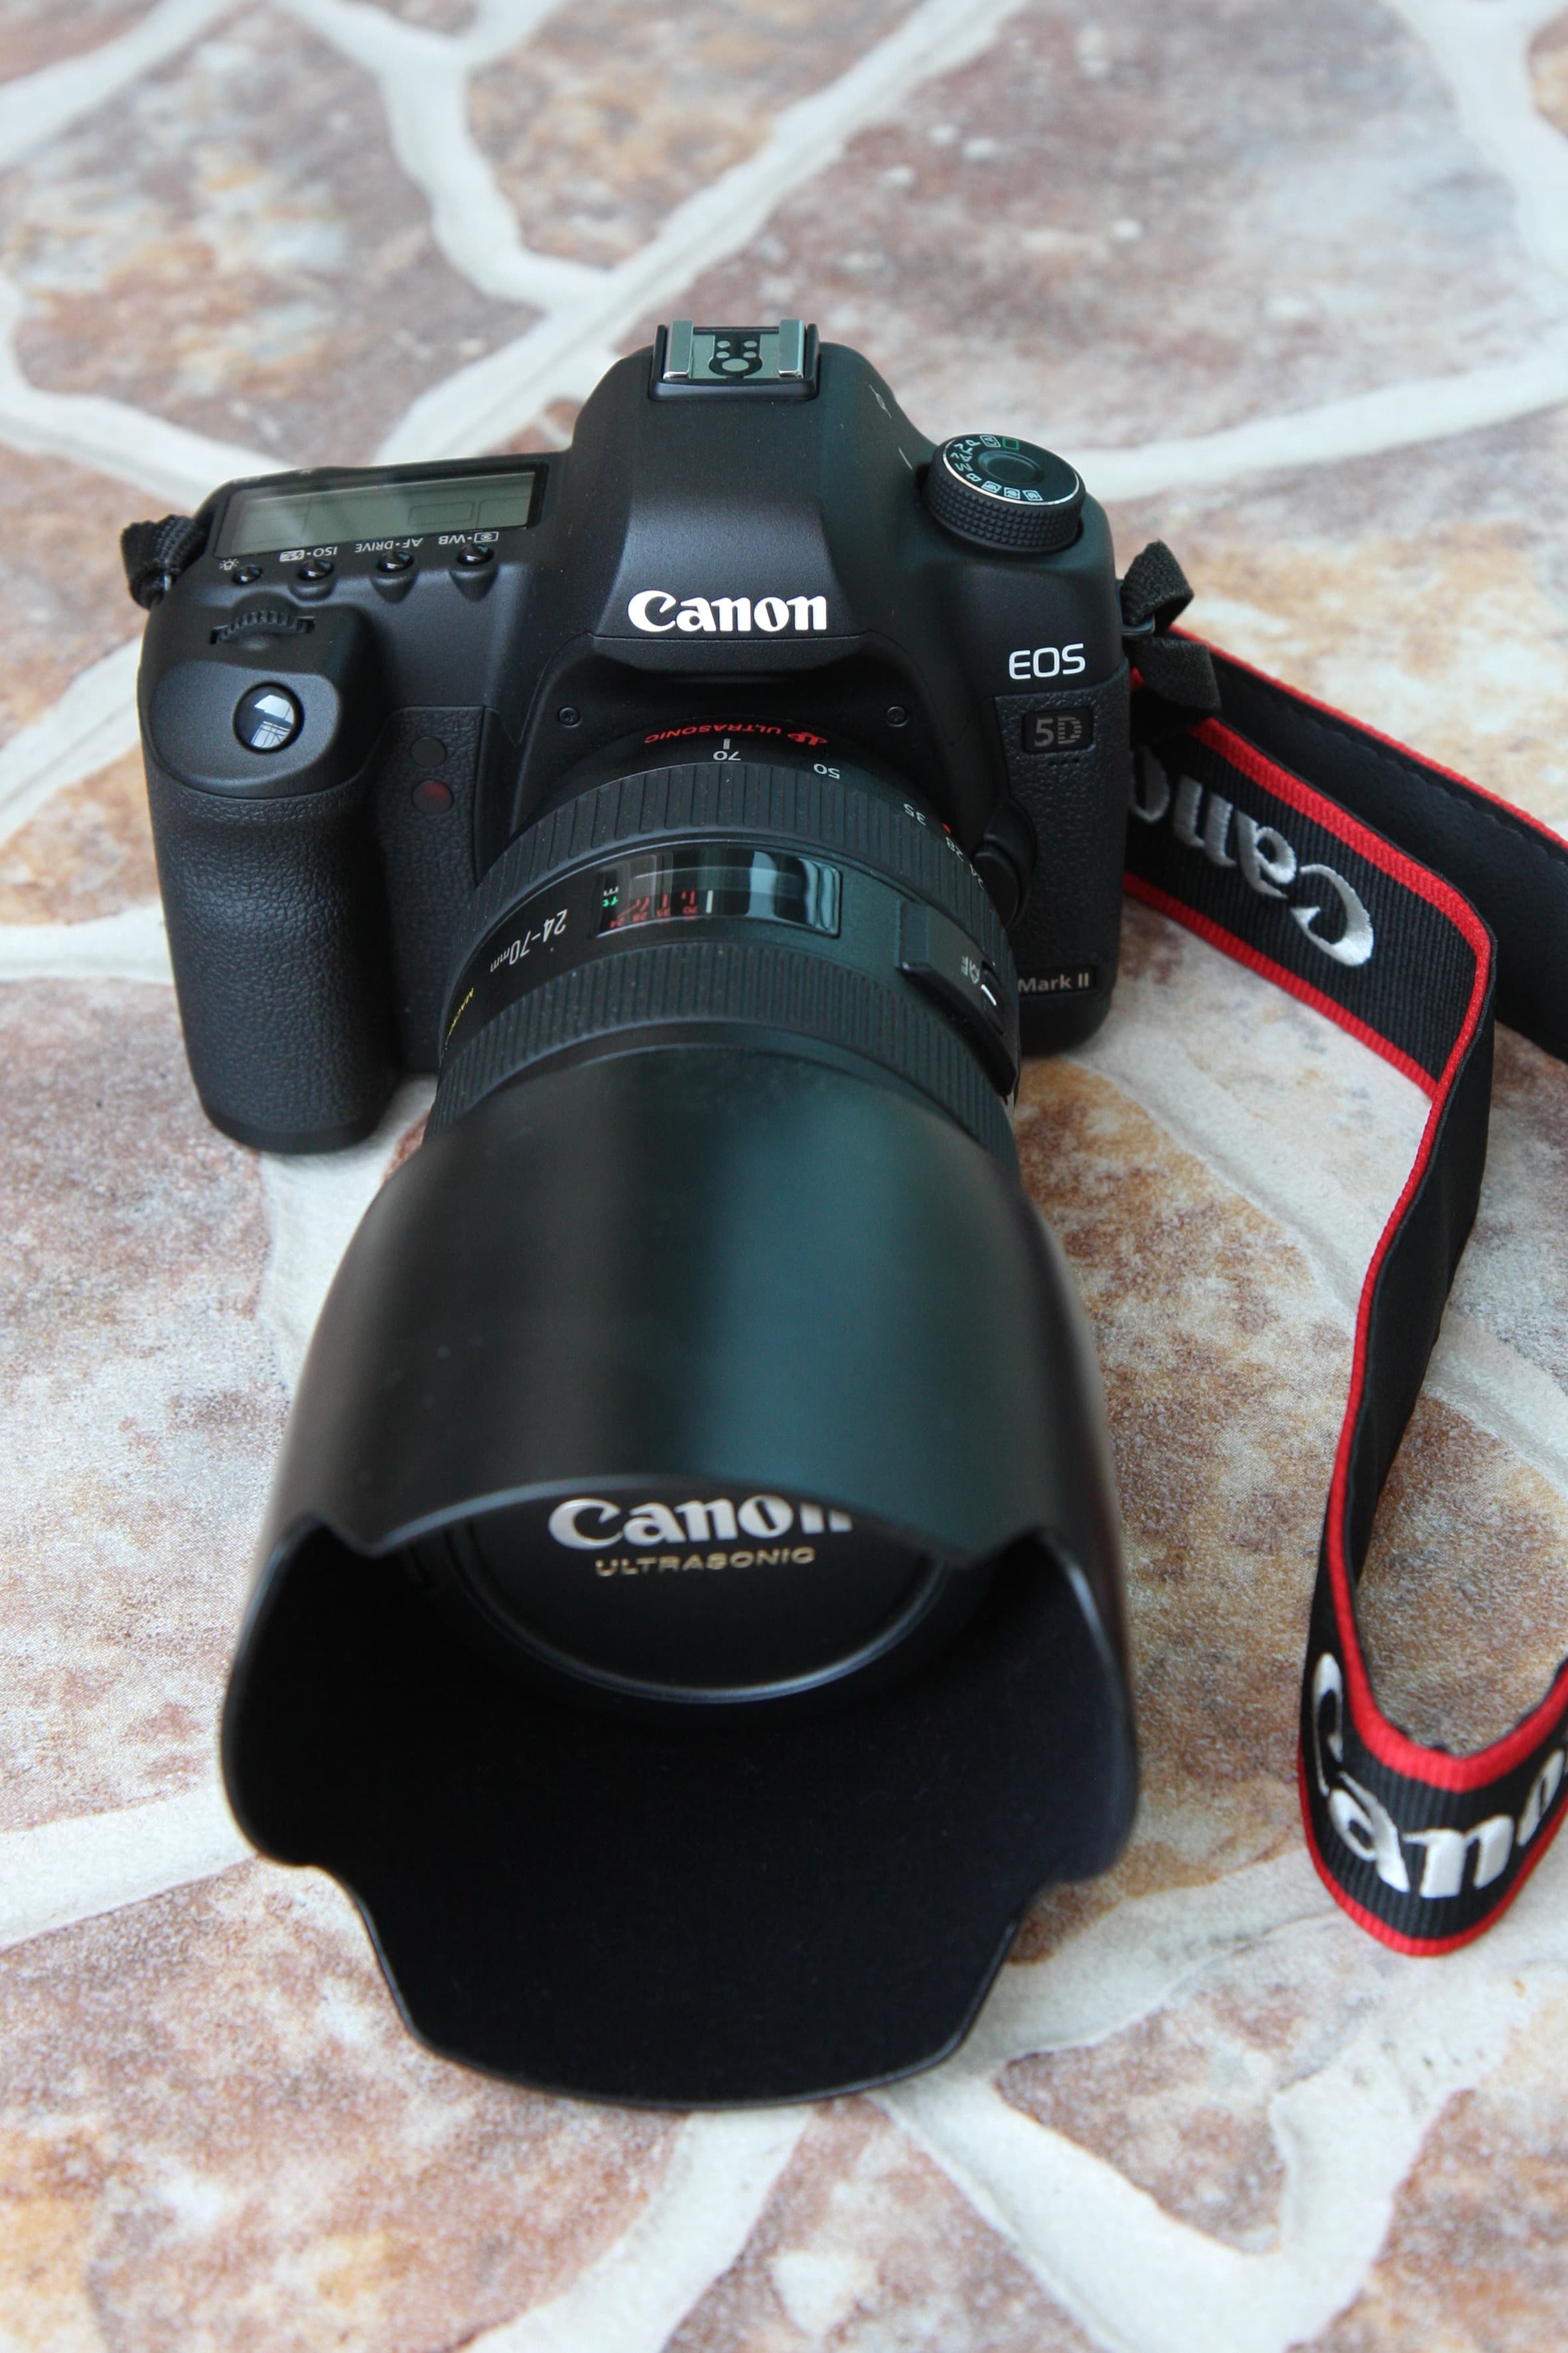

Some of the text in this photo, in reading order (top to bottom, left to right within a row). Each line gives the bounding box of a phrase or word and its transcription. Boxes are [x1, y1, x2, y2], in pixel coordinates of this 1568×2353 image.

[965, 473, 982, 482] B
[628, 589, 827, 632] Canon
[1008, 643, 1086, 680] EOS
[644, 723, 782, 744] ULTRASONIC
[1034, 715, 1083, 747] 5D
[712, 750, 742, 761] 70
[813, 763, 841, 780] 50
[902, 802, 927, 826] 35
[1127, 744, 1374, 967] Cano
[1017, 972, 1090, 993] Mark II
[596, 1546, 816, 1577] ULTRASONIC
[1313, 1652, 1568, 1899] Cano
